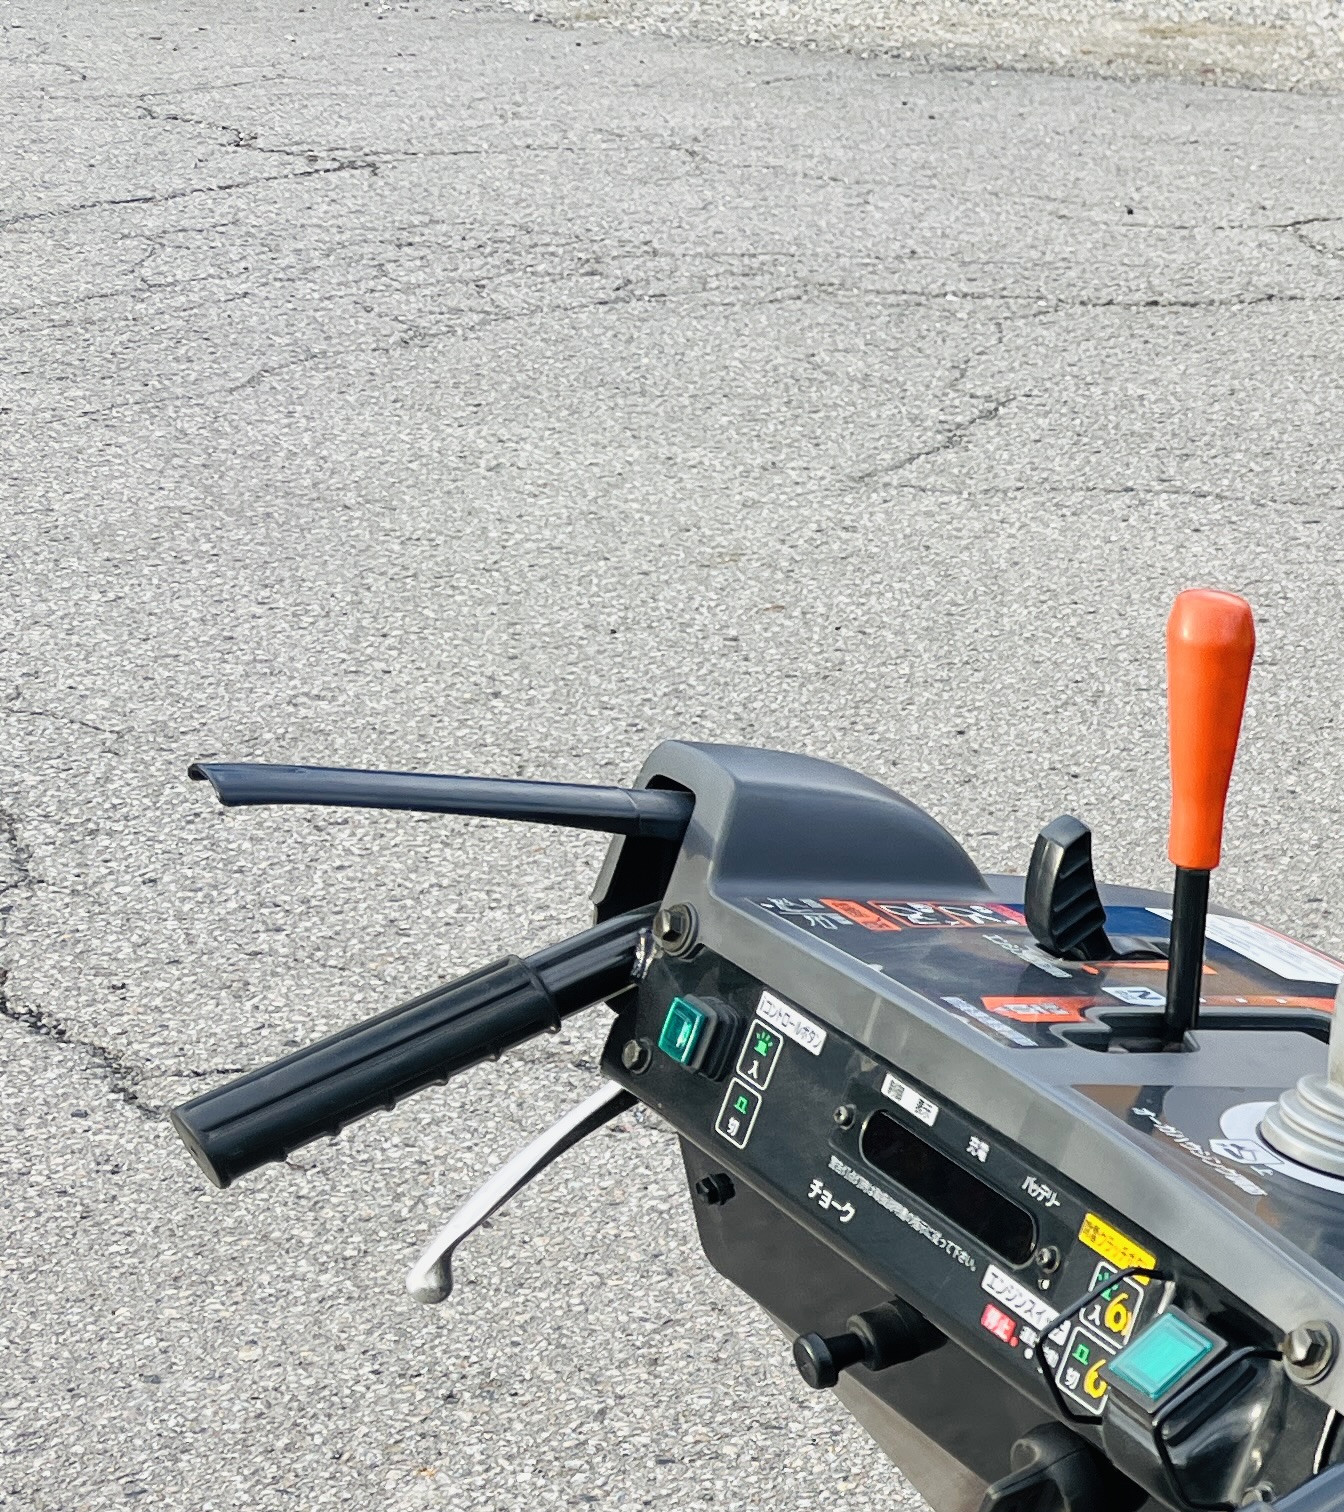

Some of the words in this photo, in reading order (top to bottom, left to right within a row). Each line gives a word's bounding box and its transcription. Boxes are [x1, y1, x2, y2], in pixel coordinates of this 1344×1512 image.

[747, 1060, 759, 1079] 入
[807, 1178, 856, 1223] チョーク
[986, 1271, 1064, 1337] エンジンスイチ
